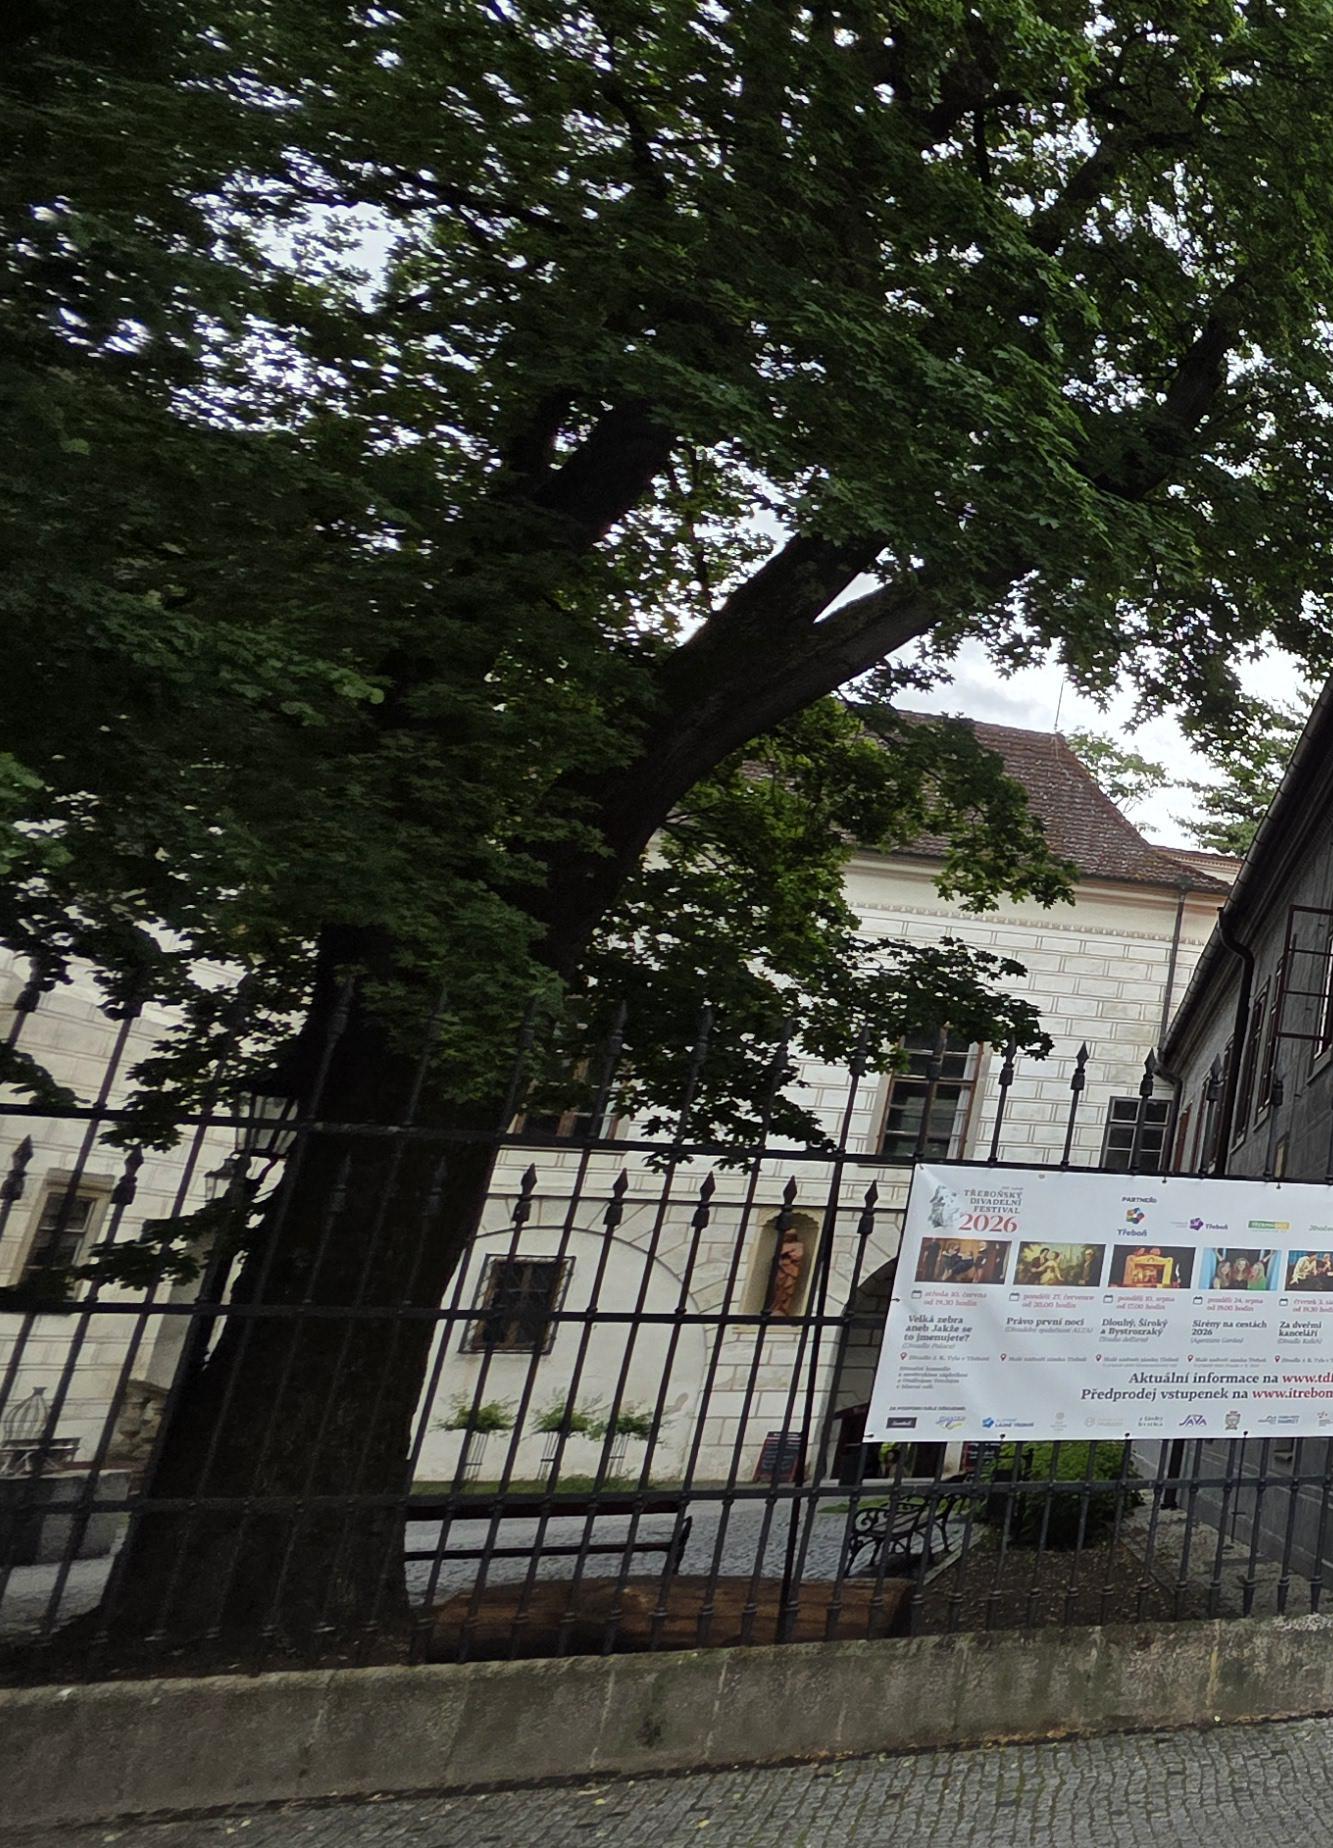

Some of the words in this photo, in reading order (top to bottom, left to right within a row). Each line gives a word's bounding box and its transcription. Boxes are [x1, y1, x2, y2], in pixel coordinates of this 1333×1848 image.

[963, 1188, 1023, 1199] TŘEBOŇSKÝ
[969, 1197, 1022, 1206] DIVADELNÍ
[973, 1205, 1021, 1214] FESTIVAL
[958, 1212, 1018, 1233] 2026
[1117, 1228, 1148, 1237] Třeboň
[908, 1315, 935, 1324] Velká
[937, 1315, 964, 1324] zebra
[1006, 1317, 1034, 1326] Právo
[1035, 1317, 1063, 1327] první
[1064, 1318, 1085, 1326] noci
[1138, 1317, 1169, 1328] Široký
[1192, 1319, 1222, 1329] Sirény
[1235, 1320, 1268, 1329] cestách
[1279, 1321, 1291, 1329] Za
[1292, 1320, 1322, 1329] dveřmi
[905, 1324, 930, 1332] aneb
[931, 1324, 960, 1333] Jakže
[962, 1325, 973, 1333] se
[1108, 1327, 1164, 1337] Bystrozraký
[1191, 1328, 1213, 1336] 2026
[1278, 1328, 1318, 1337] kanceláří
[903, 1333, 915, 1341] to
[915, 1333, 971, 1344] jmenujete?
[1128, 1371, 1189, 1384] Aktuální
[1192, 1372, 1260, 1385] informace
[1262, 1374, 1279, 1384] na
[1080, 1388, 1157, 1401] Předprodej
[1160, 1387, 1229, 1400] vstupenek
[1232, 1390, 1248, 1400] na
